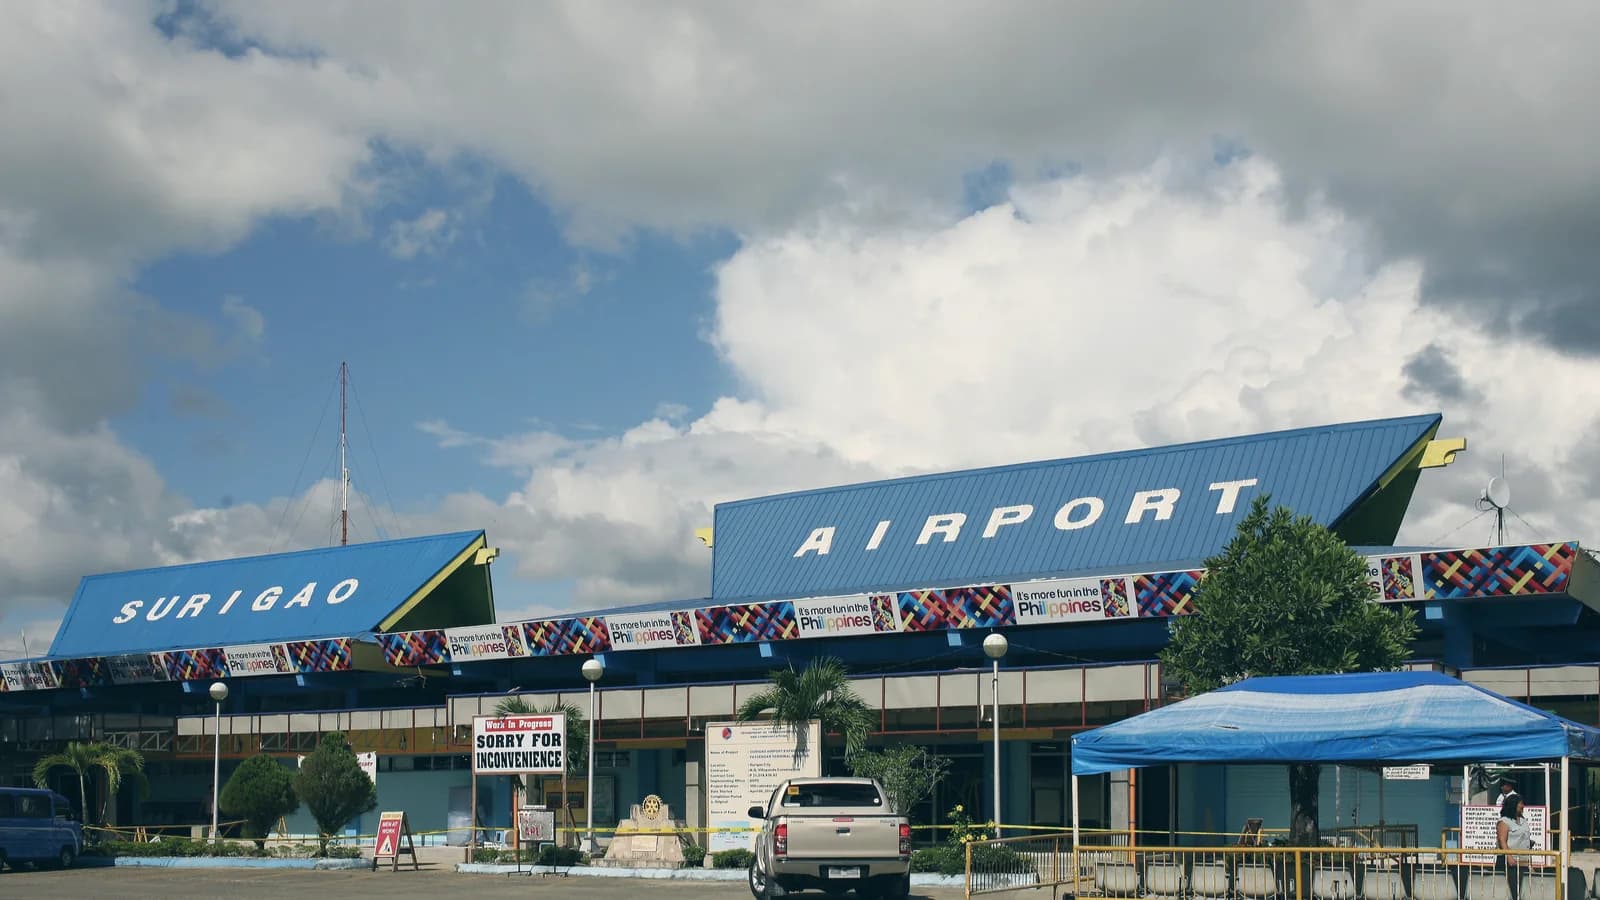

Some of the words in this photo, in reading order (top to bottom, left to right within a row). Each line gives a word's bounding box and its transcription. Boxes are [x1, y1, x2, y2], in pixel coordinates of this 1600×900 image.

[793, 478, 1259, 558] AIRPORT
[112, 578, 360, 625] SURIGAO
[1016, 591, 1029, 600] It's
[1030, 591, 1056, 600] more
[1057, 588, 1073, 598] fun
[1073, 588, 1081, 597] in
[1082, 587, 1099, 596] the
[810, 607, 833, 615] more
[833, 604, 847, 613] fun
[847, 604, 855, 612] in
[855, 603, 869, 612] the
[1018, 599, 1101, 618] Philippines
[639, 620, 651, 628] fun
[801, 614, 872, 632] Philippines
[612, 629, 674, 645] Philippines
[451, 642, 506, 656] Philippines
[486, 720, 505, 729] Work
[508, 720, 516, 729] In
[520, 719, 552, 730] Progress
[476, 733, 525, 749] SORRY
[532, 733, 562, 747] FOR
[476, 750, 562, 769] INCONVENIENCE
